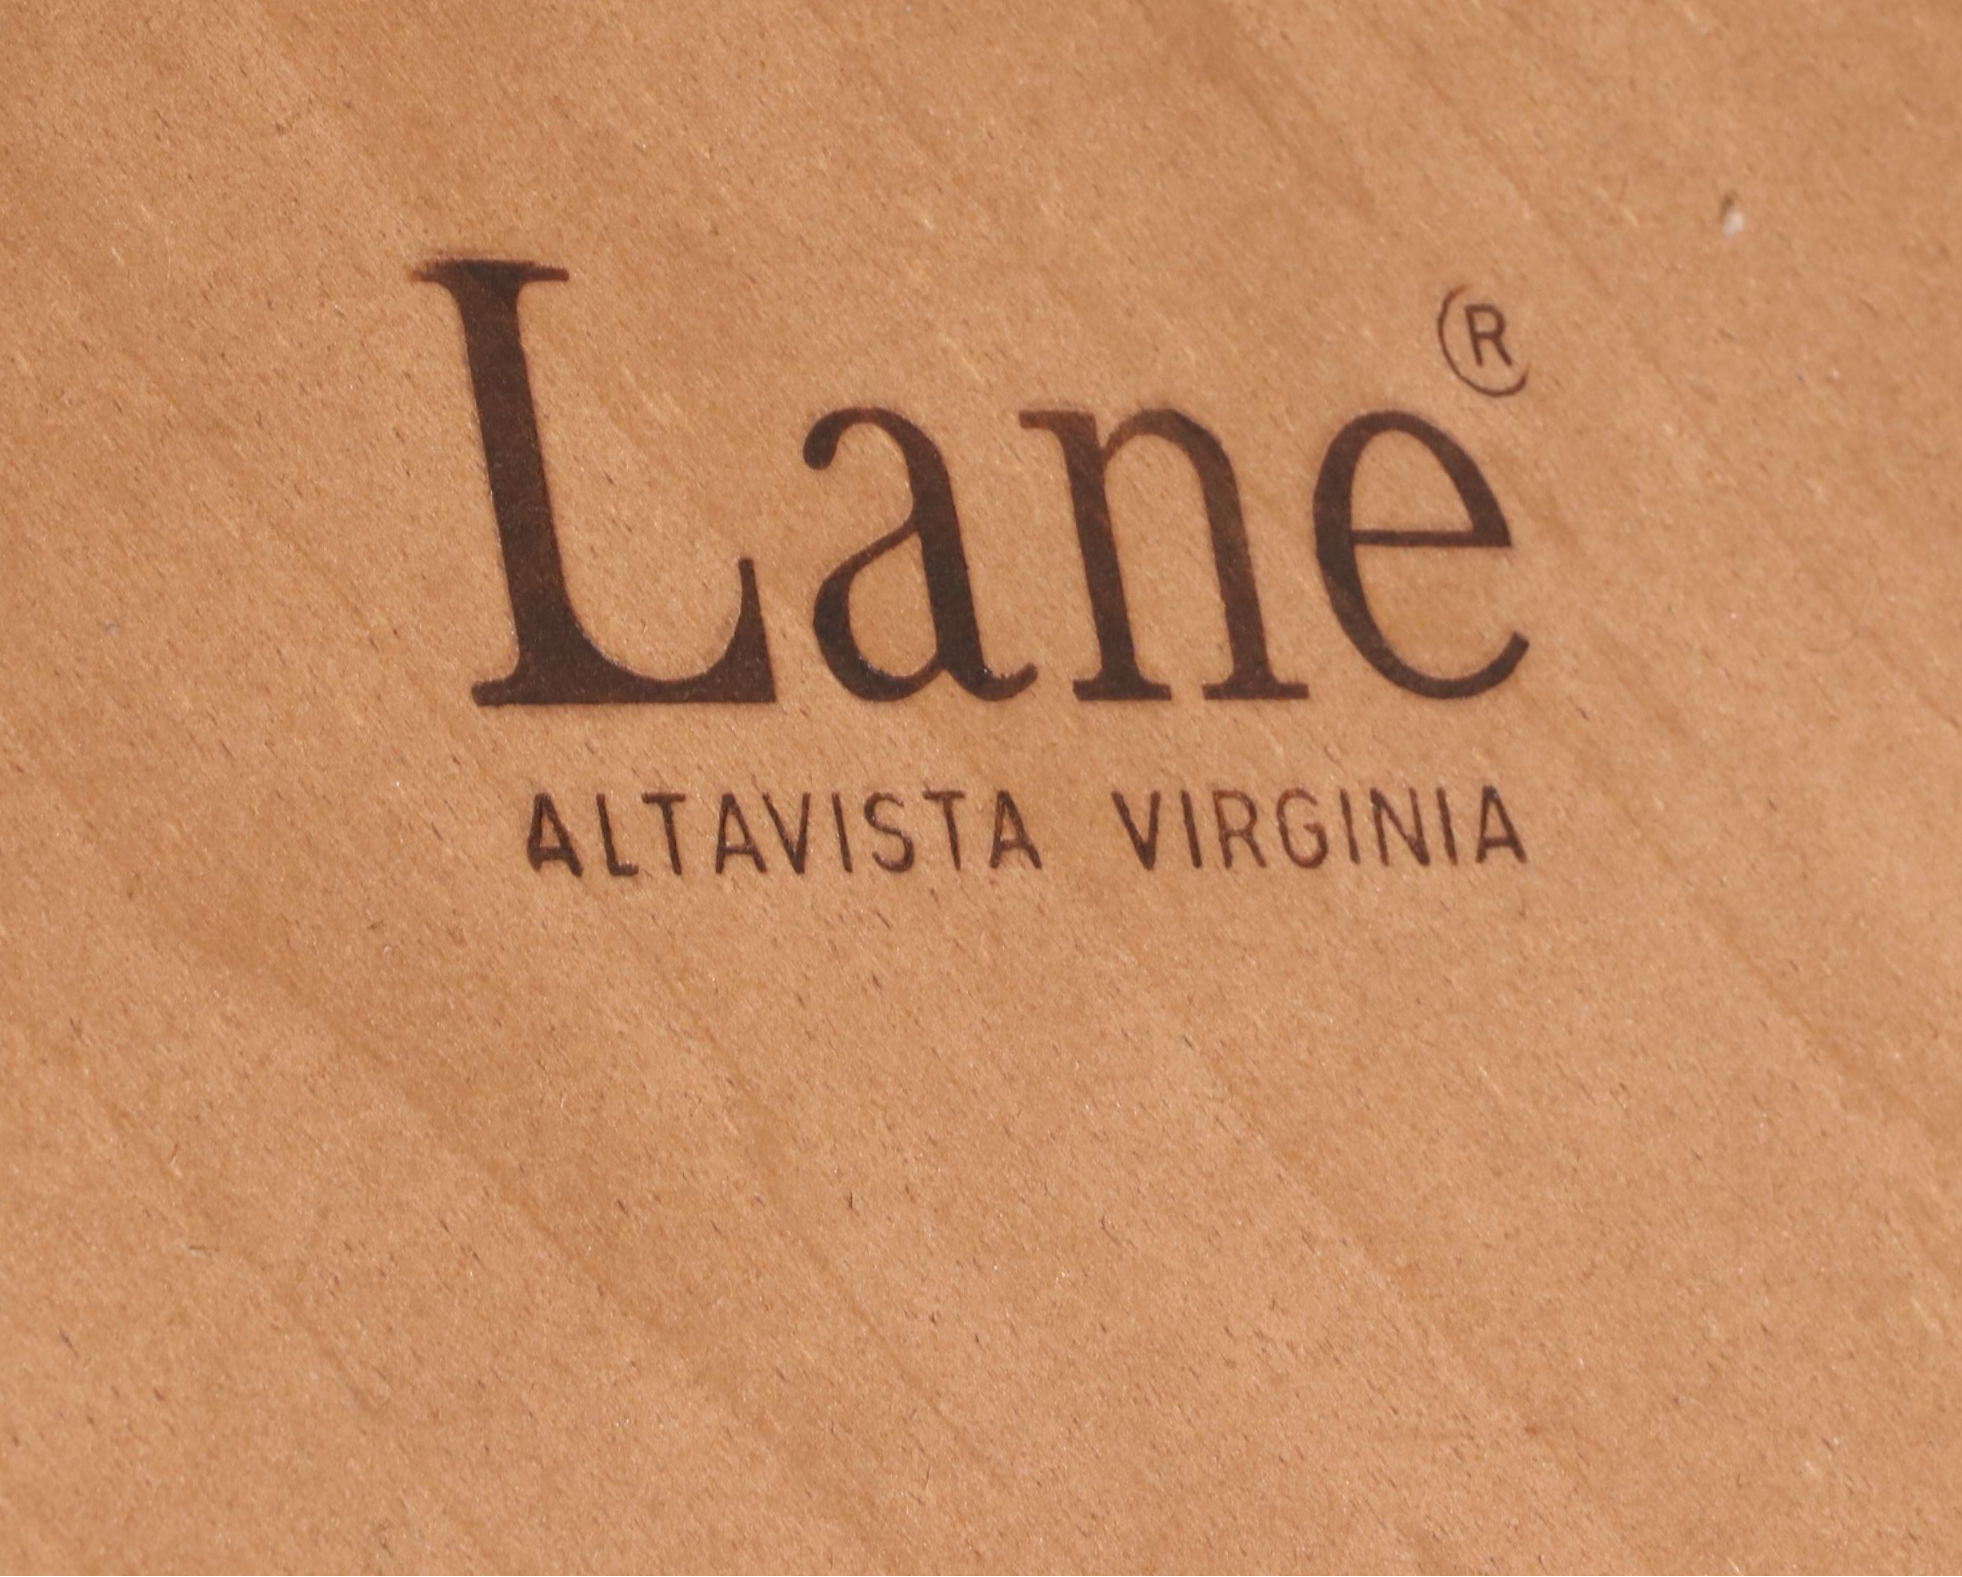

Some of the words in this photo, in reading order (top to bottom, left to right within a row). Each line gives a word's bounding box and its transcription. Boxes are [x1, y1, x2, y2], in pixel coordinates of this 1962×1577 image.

[410, 257, 1531, 708] Lane
[527, 791, 1041, 879] ALTAVISTA
[1112, 785, 1528, 872] VIRGINIA
